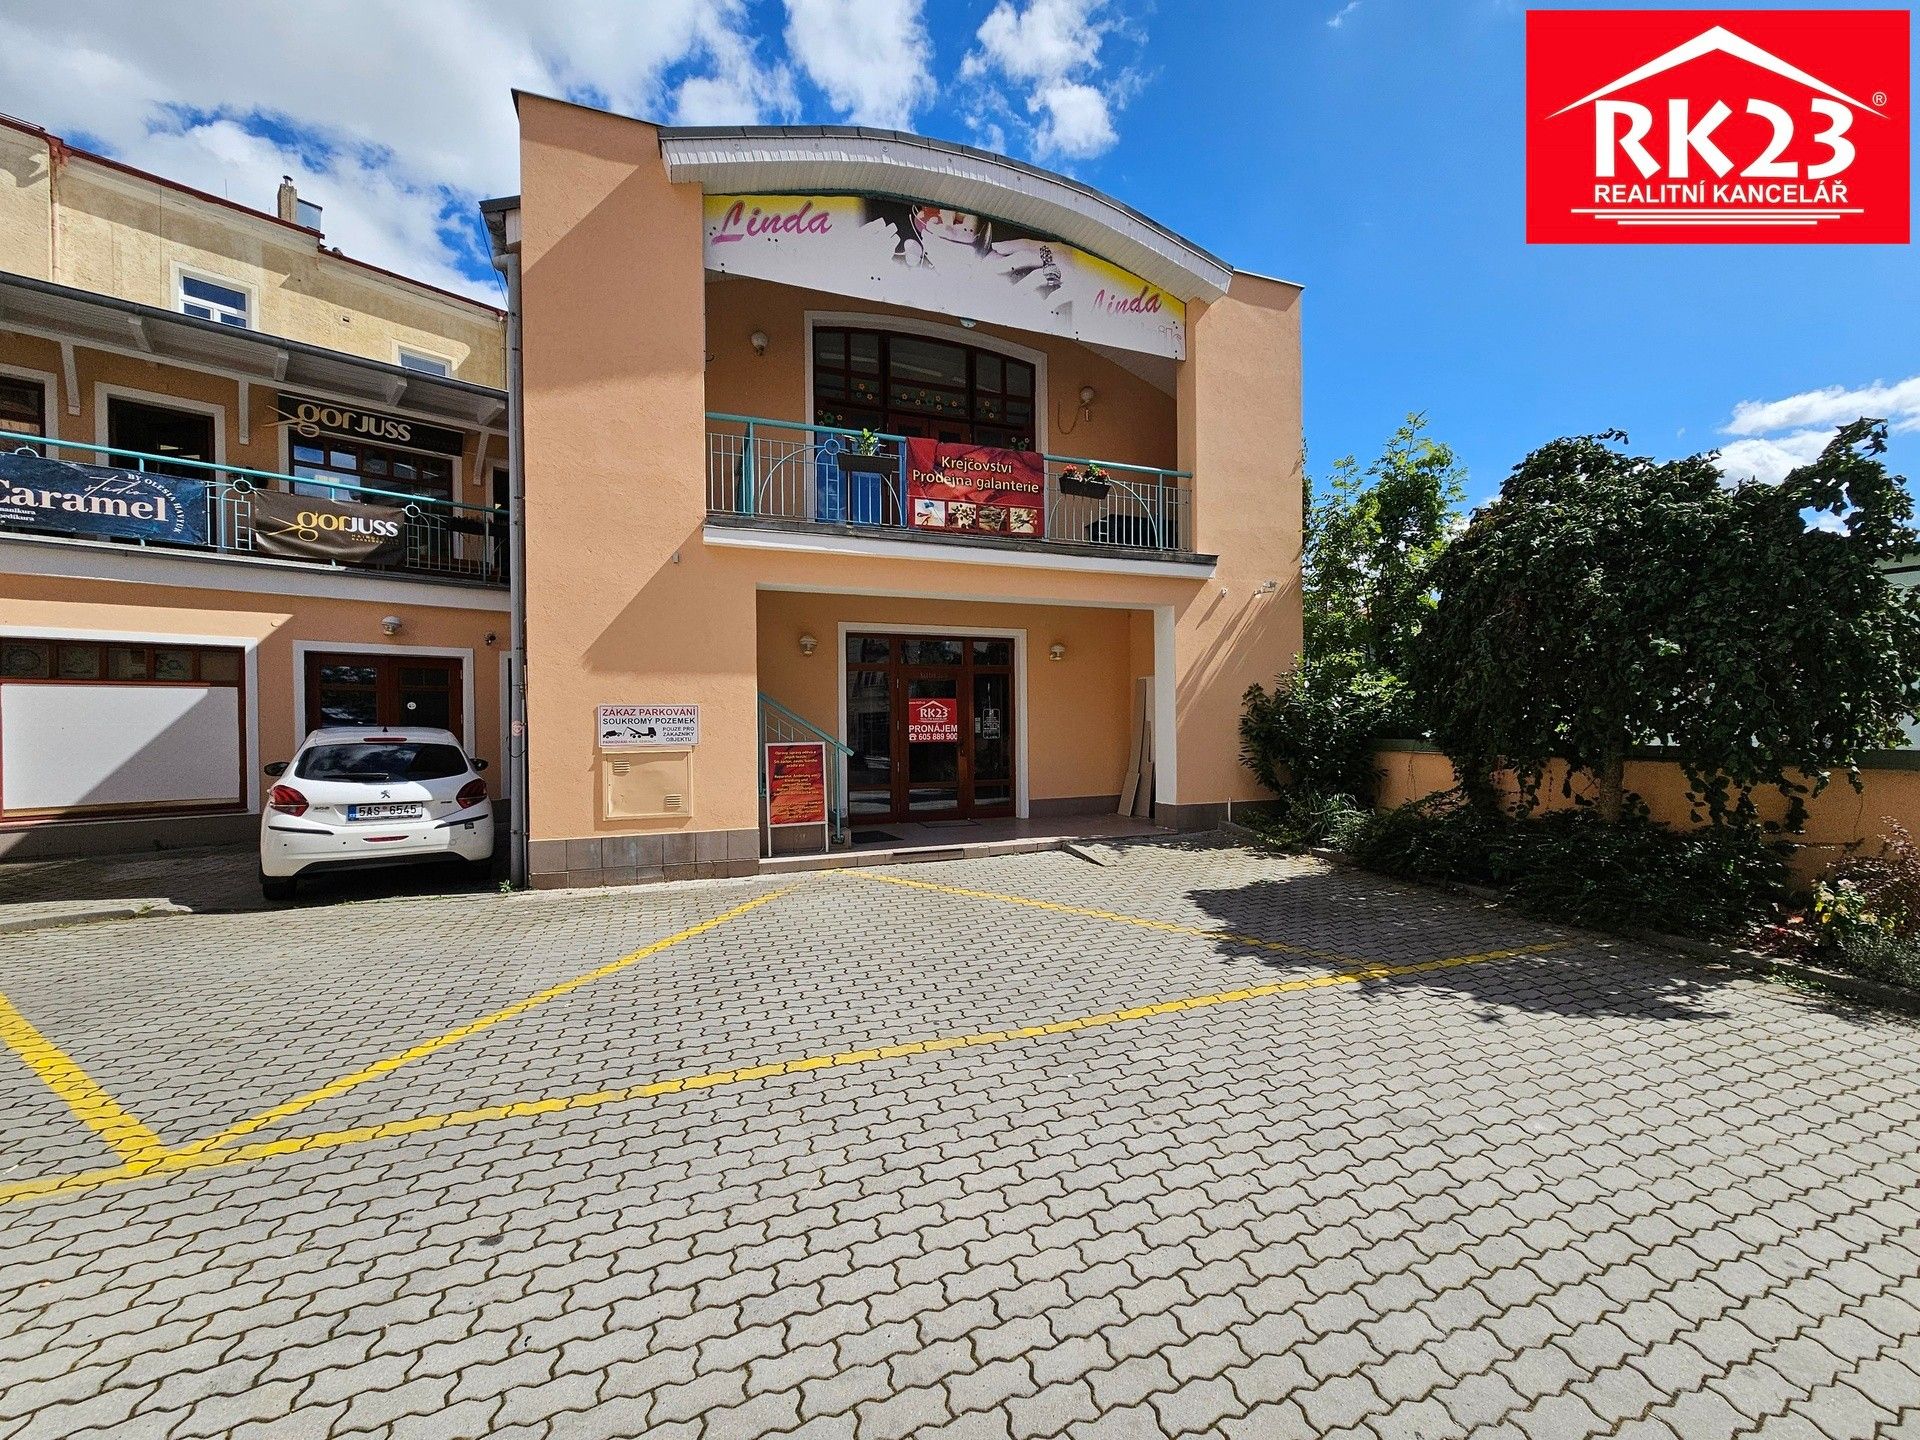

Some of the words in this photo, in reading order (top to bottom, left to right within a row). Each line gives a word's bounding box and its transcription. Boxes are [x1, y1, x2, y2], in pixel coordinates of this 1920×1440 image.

[711, 200, 833, 246] Linda
[941, 456, 1013, 474] Krejčovství
[912, 469, 973, 488] Prodejna
[976, 478, 1040, 494] galanterie
[919, 708, 949, 718] RK23
[603, 717, 653, 725] SOUKROMÝ
[655, 717, 696, 725] POZEMEK
[909, 723, 958, 733] PRONÁJEM
[918, 733, 931, 741] 605
[932, 733, 945, 741] 889
[946, 733, 958, 741] 900
[359, 806, 381, 817] 5AS
[389, 804, 417, 815] 6545
